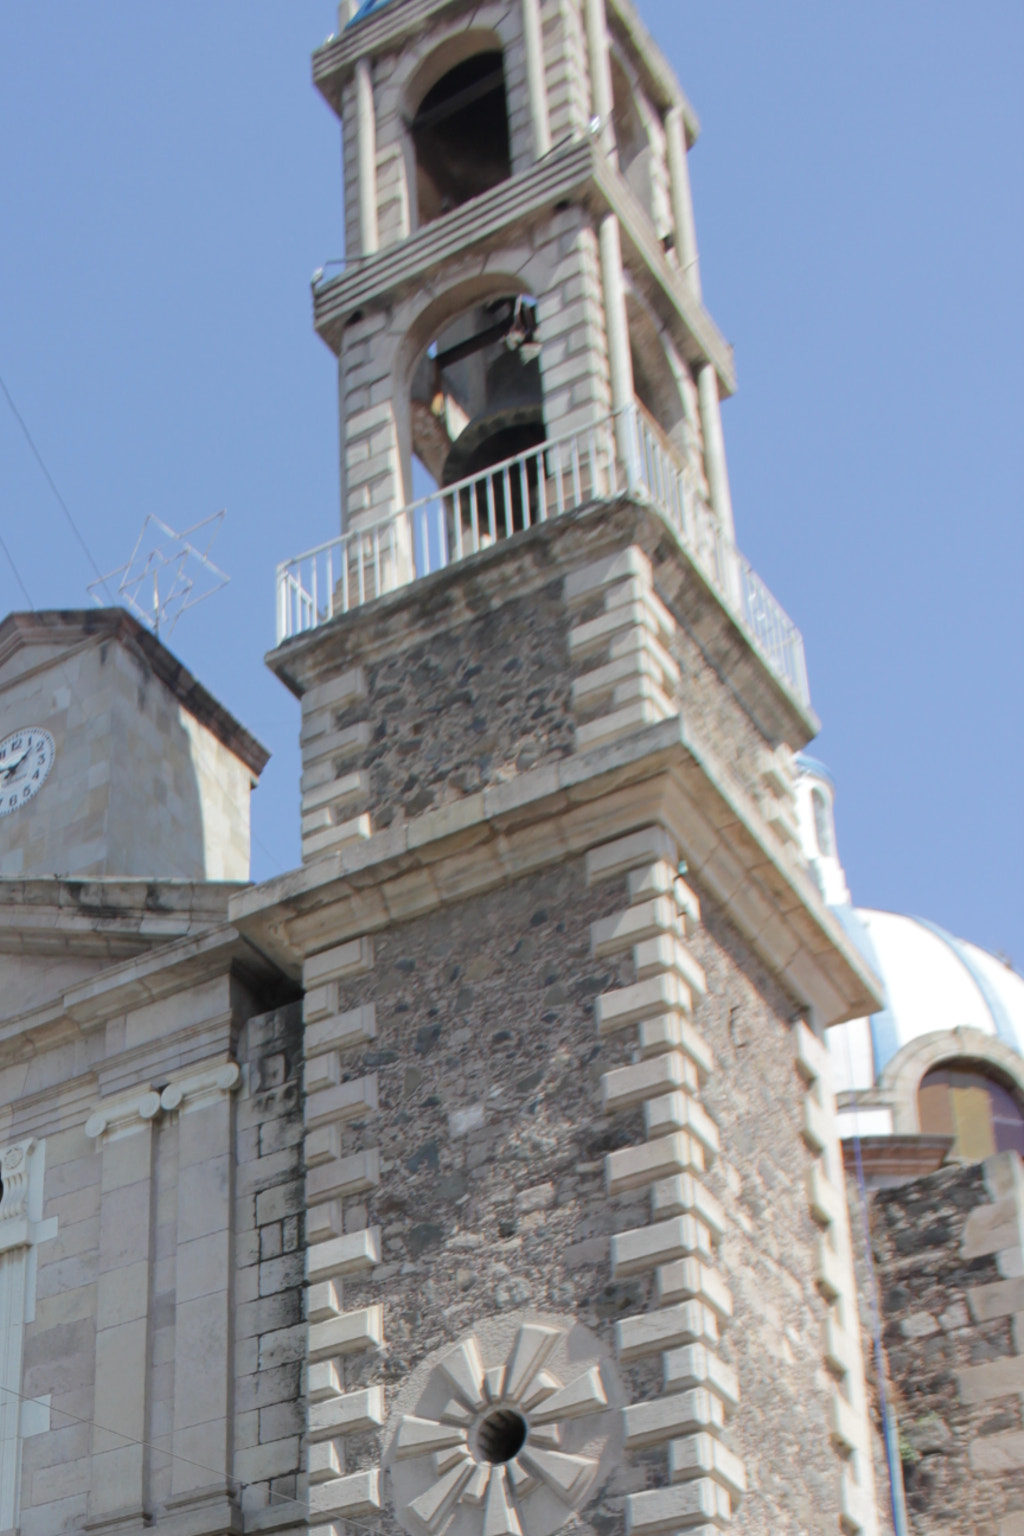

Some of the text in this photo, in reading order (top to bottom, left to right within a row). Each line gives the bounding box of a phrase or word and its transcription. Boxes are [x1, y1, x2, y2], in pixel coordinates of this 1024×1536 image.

[11, 740, 22, 751] 12
[37, 741, 44, 752] 2
[38, 753, 45, 765] 3
[32, 769, 39, 779] 4
